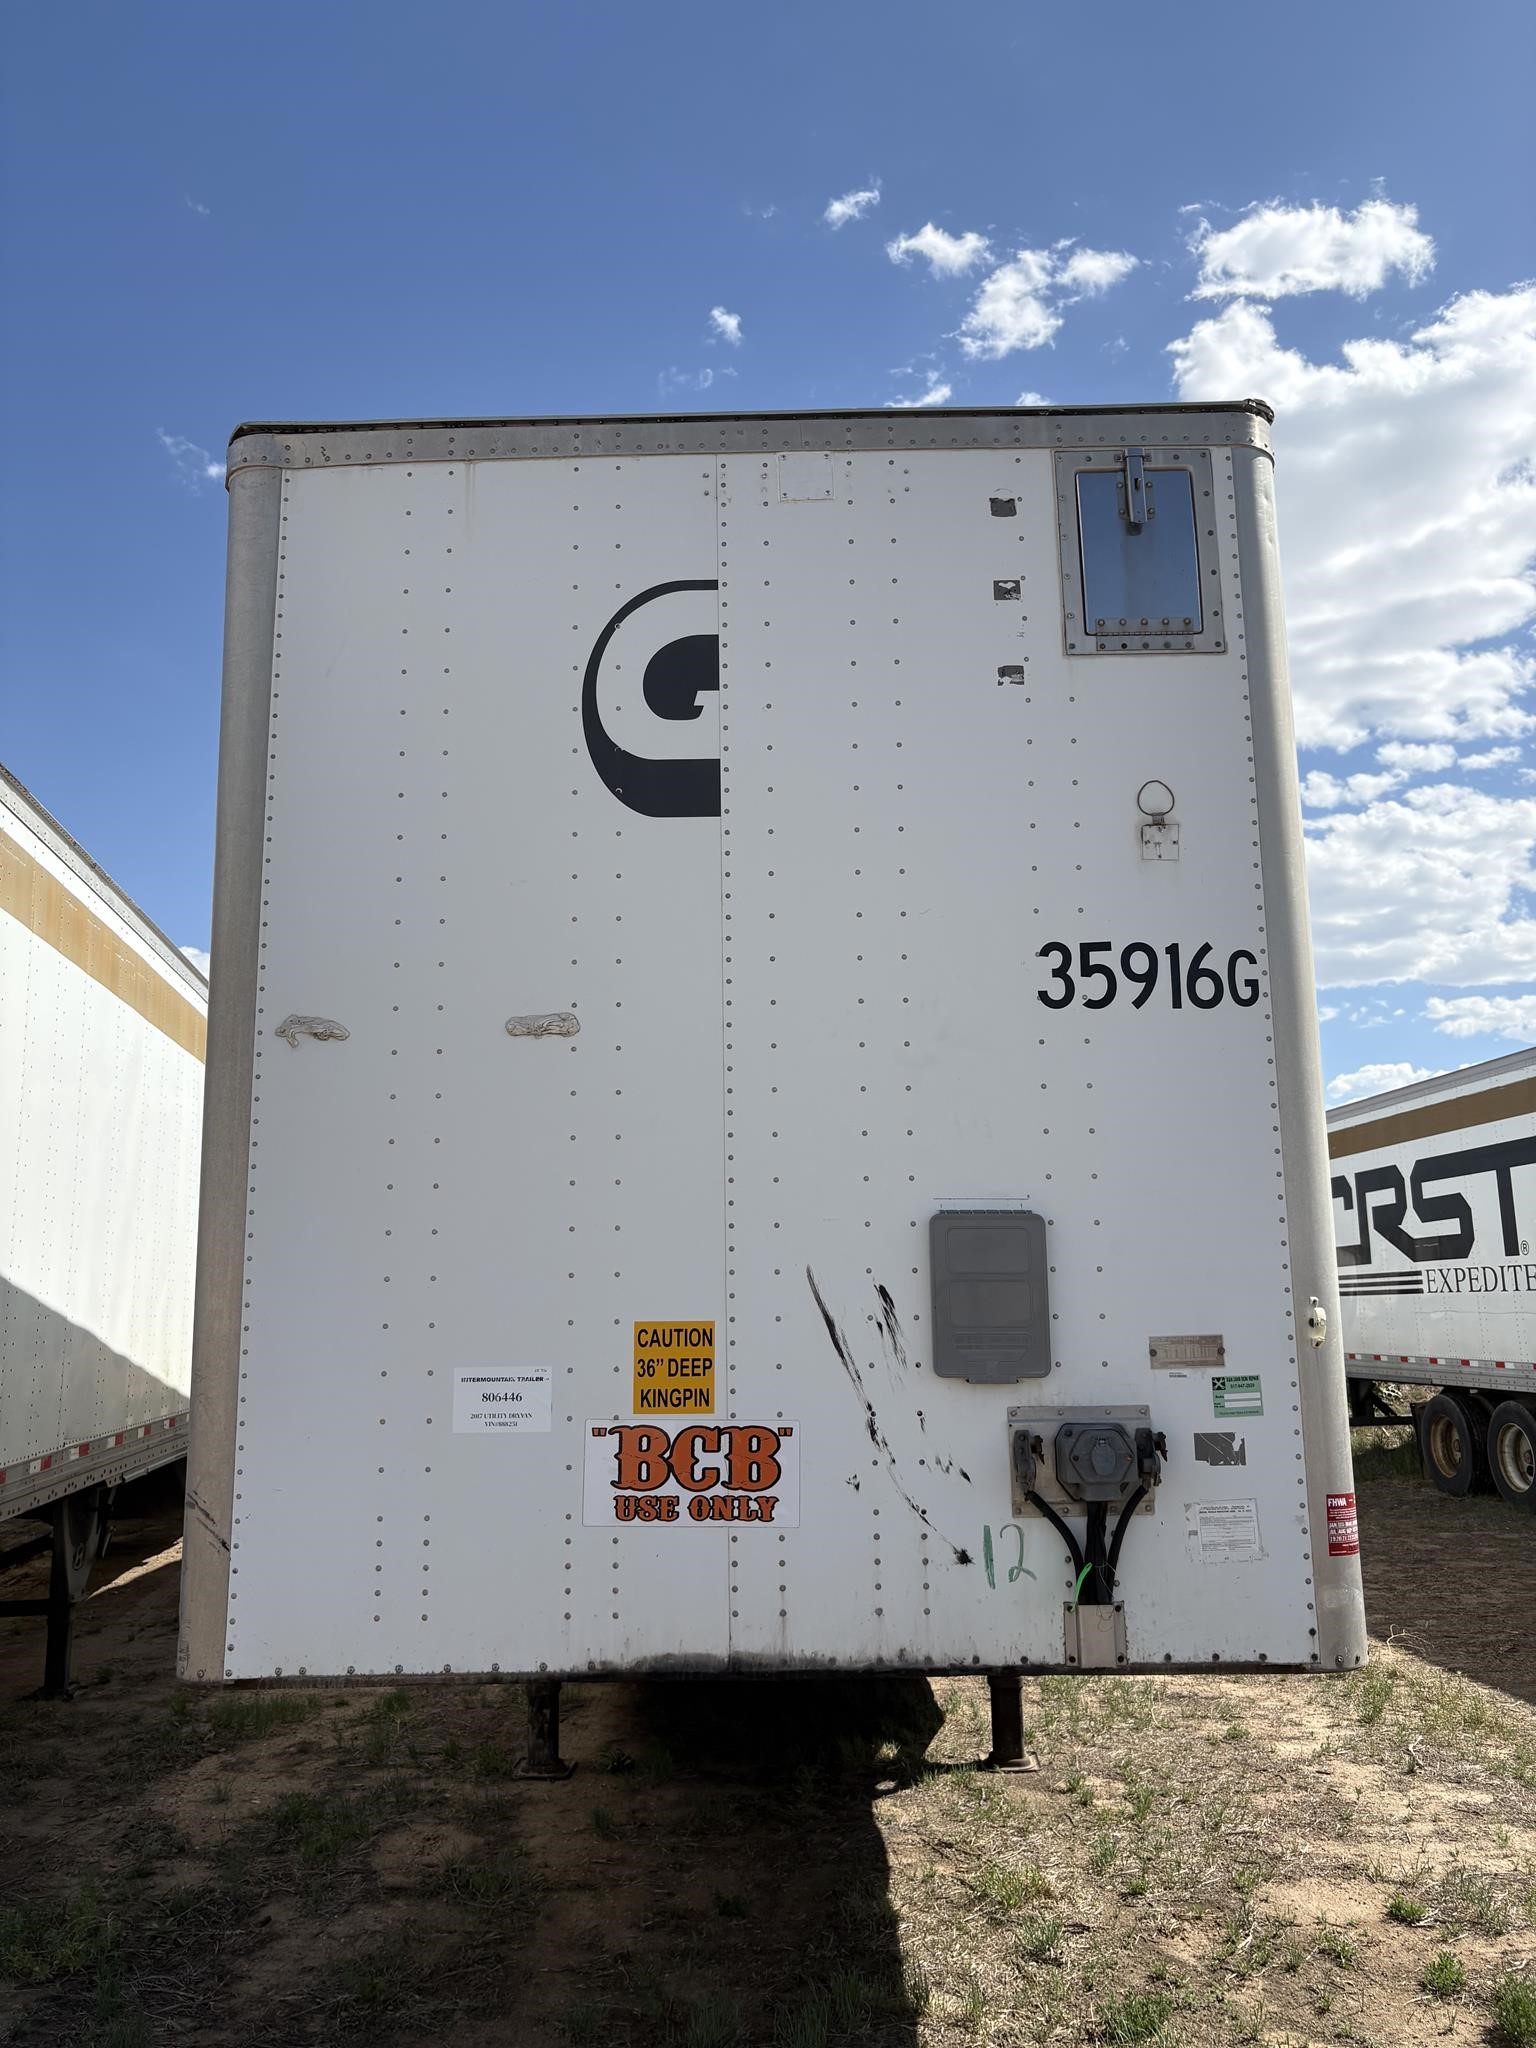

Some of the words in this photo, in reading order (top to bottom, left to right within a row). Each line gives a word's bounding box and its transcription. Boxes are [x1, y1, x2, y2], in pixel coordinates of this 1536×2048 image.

[1037, 941, 1260, 1010] 35916G
[1425, 1264, 1536, 1294] EXPEDITE
[637, 1327, 713, 1348] CAUTION
[667, 1358, 713, 1377] DEEP
[481, 1392, 523, 1402] 806446
[640, 1388, 710, 1408] KINGPIN
[613, 1495, 680, 1522] USE
[687, 1495, 779, 1522] ONLY
[1328, 1497, 1347, 1507] FHWA
[983, 1524, 1037, 1590] 12
